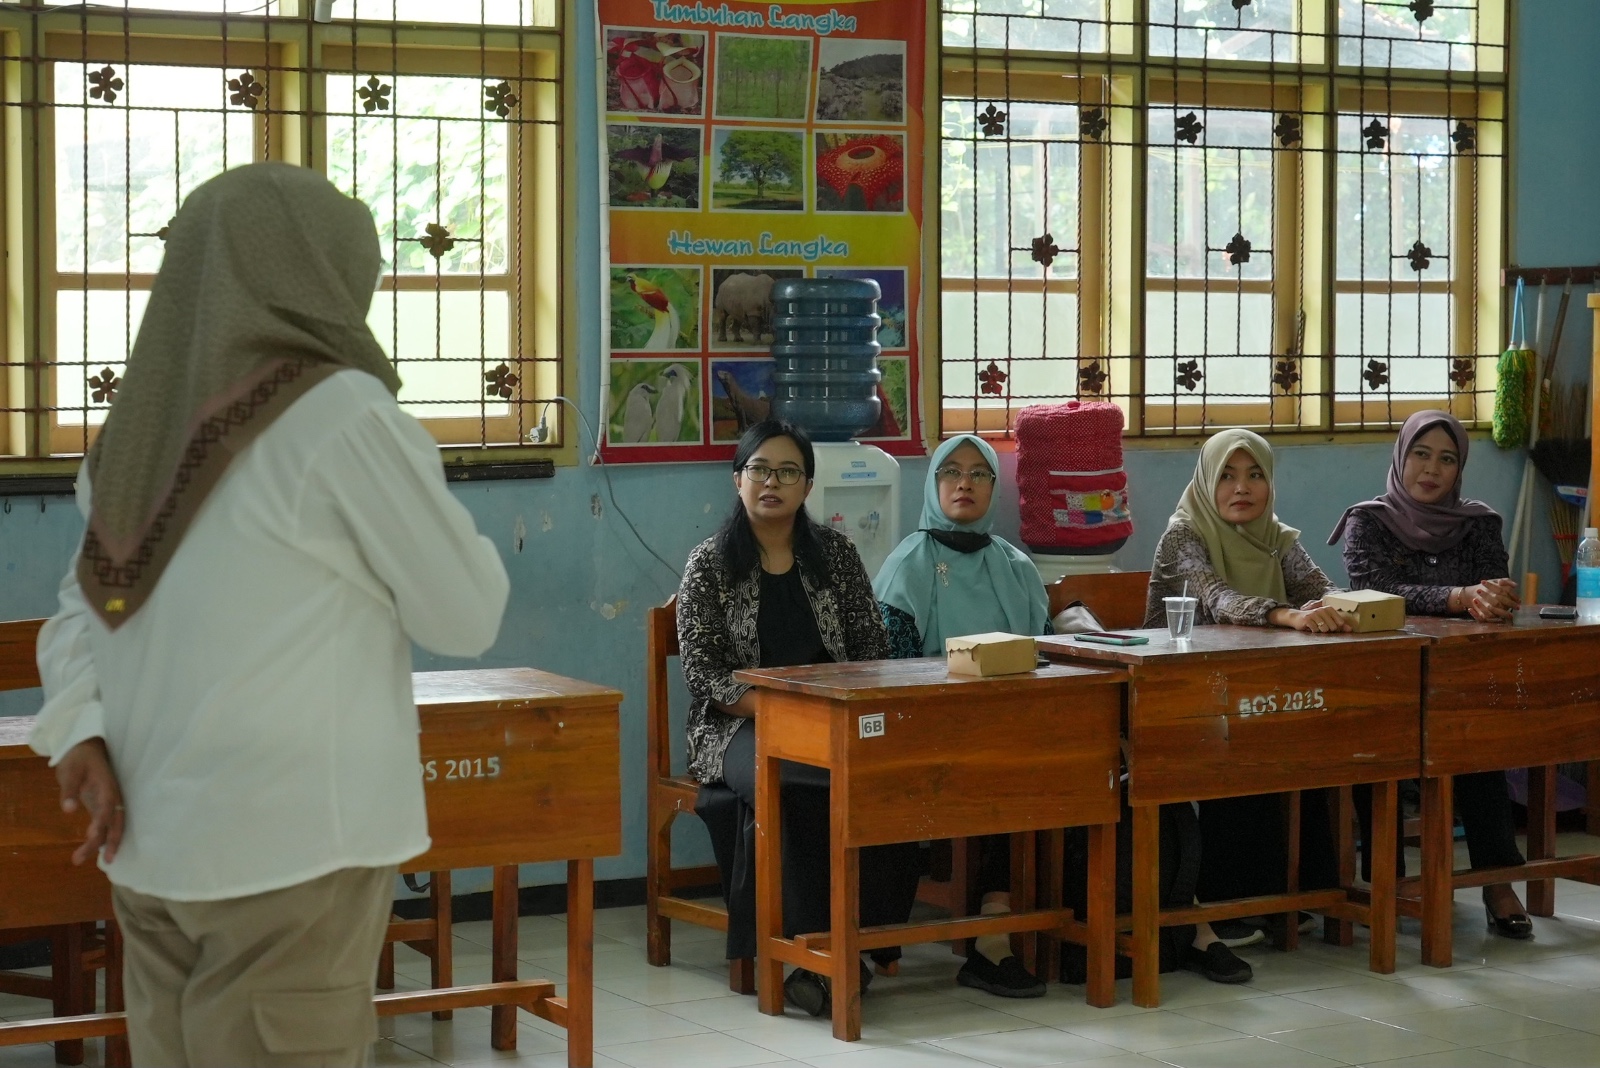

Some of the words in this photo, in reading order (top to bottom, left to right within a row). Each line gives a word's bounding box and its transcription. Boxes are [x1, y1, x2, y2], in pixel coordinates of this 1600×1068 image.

[653, 0, 764, 28] Tumbuhan
[768, 4, 857, 36] Langka
[667, 230, 753, 256] Hewan
[758, 231, 849, 261] Langka
[1282, 688, 1324, 711] 2015
[863, 720, 883, 734] 6B
[445, 756, 500, 779] 2015
